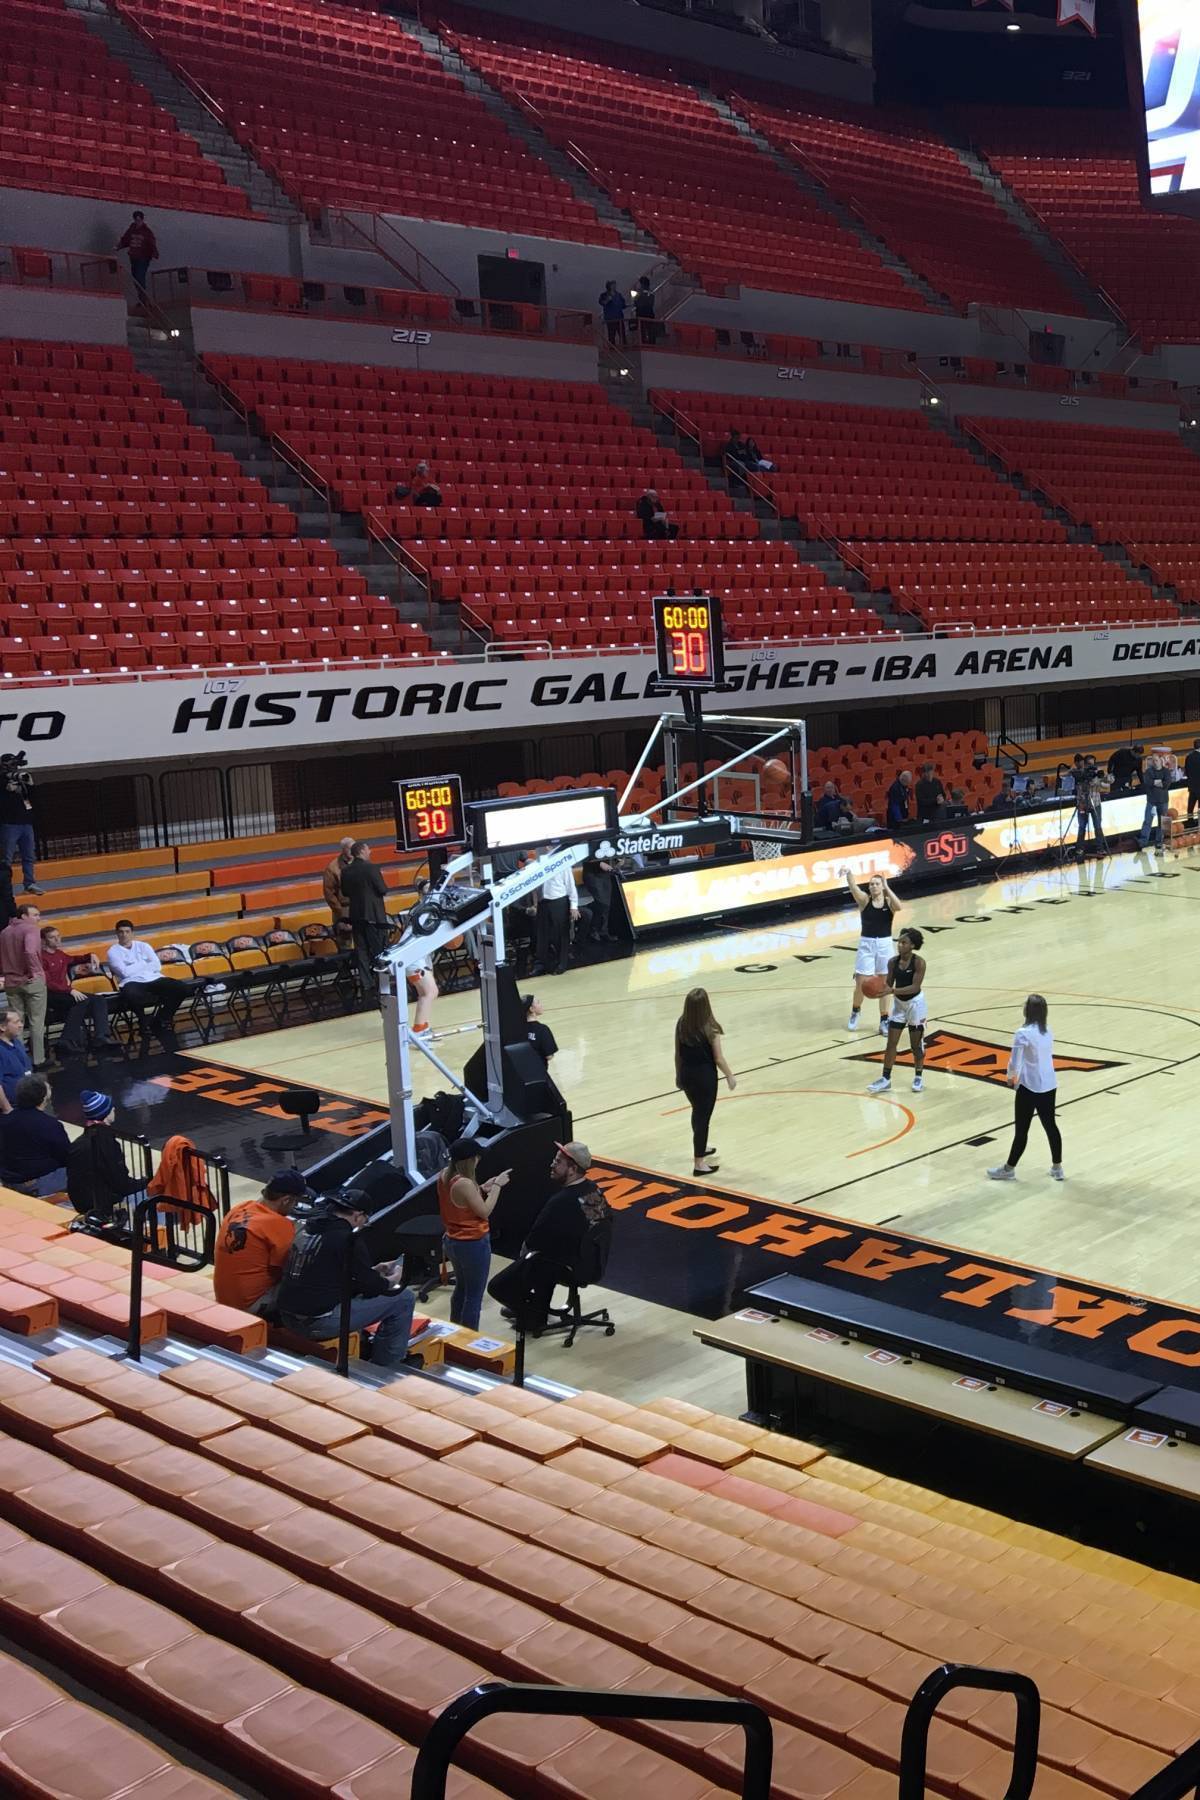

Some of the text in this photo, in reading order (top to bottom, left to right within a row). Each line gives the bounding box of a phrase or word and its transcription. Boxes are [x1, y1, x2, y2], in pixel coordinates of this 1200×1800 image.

[1062, 71, 1091, 81] 321
[391, 328, 432, 345] 213
[777, 367, 806, 380] 214
[1060, 396, 1079, 406] 215
[664, 606, 708, 629] 60:00
[671, 632, 705, 672] 30
[752, 650, 776, 661] 108
[172, 678, 508, 734] HISTORIC
[955, 644, 1073, 676] ARENA
[204, 680, 246, 694] 107
[406, 787, 452, 810] 60:00
[416, 809, 447, 837] 30
[925, 831, 968, 864] OSU
[544, 853, 573, 874] Sports
